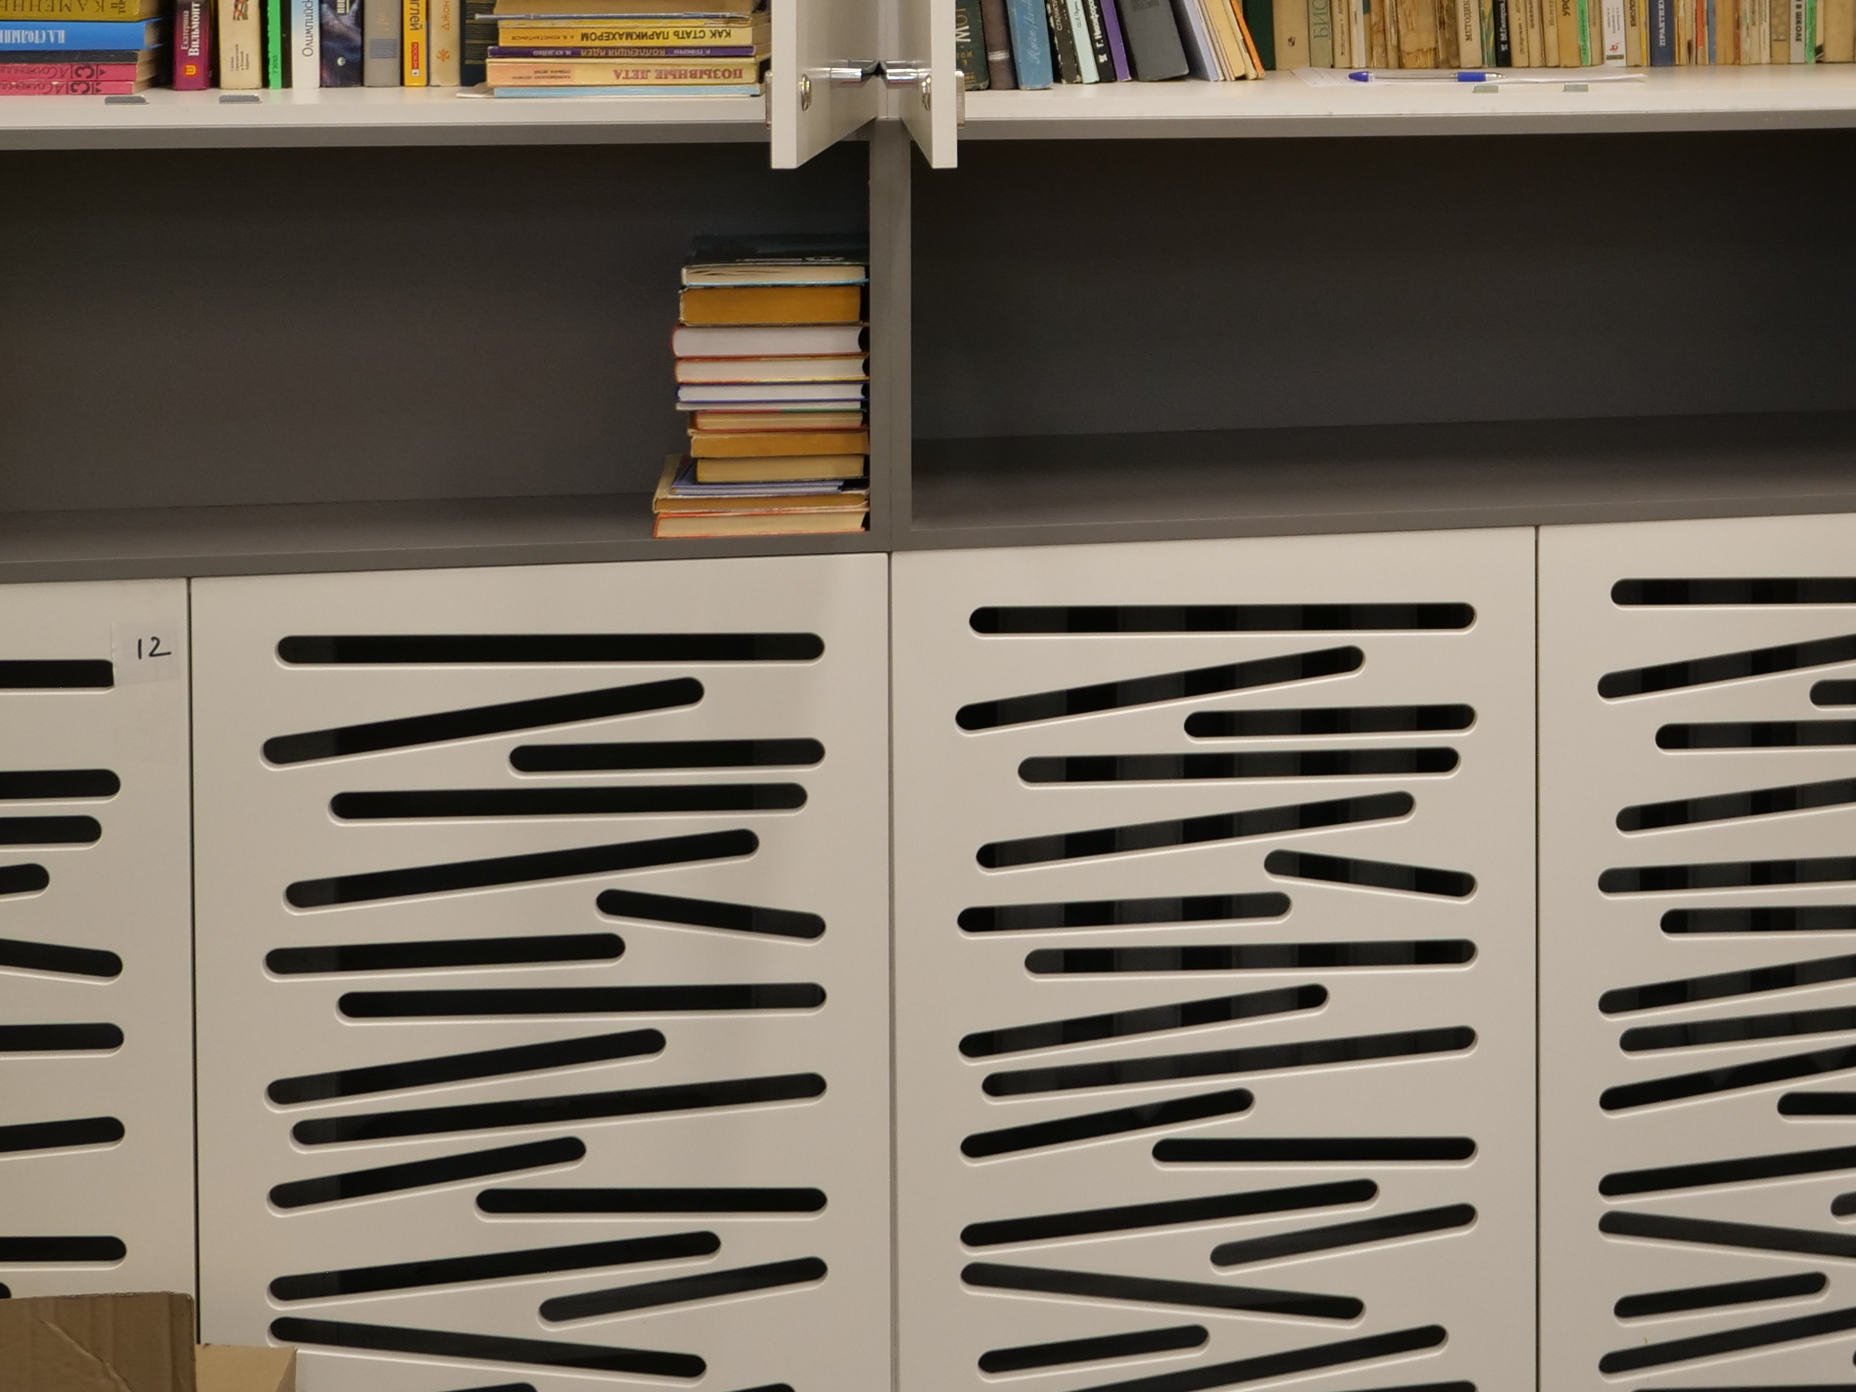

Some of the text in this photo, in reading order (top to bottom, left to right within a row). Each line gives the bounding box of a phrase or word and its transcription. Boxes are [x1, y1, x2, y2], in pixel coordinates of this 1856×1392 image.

[442, 1, 451, 31] Джон
[581, 29, 731, 42] КАК СТАТЬ ПАРИКМАХЕРОМ
[613, 69, 743, 80] ПОЗЫВНЫЕ ЛЕТА
[137, 635, 173, 661] 12
